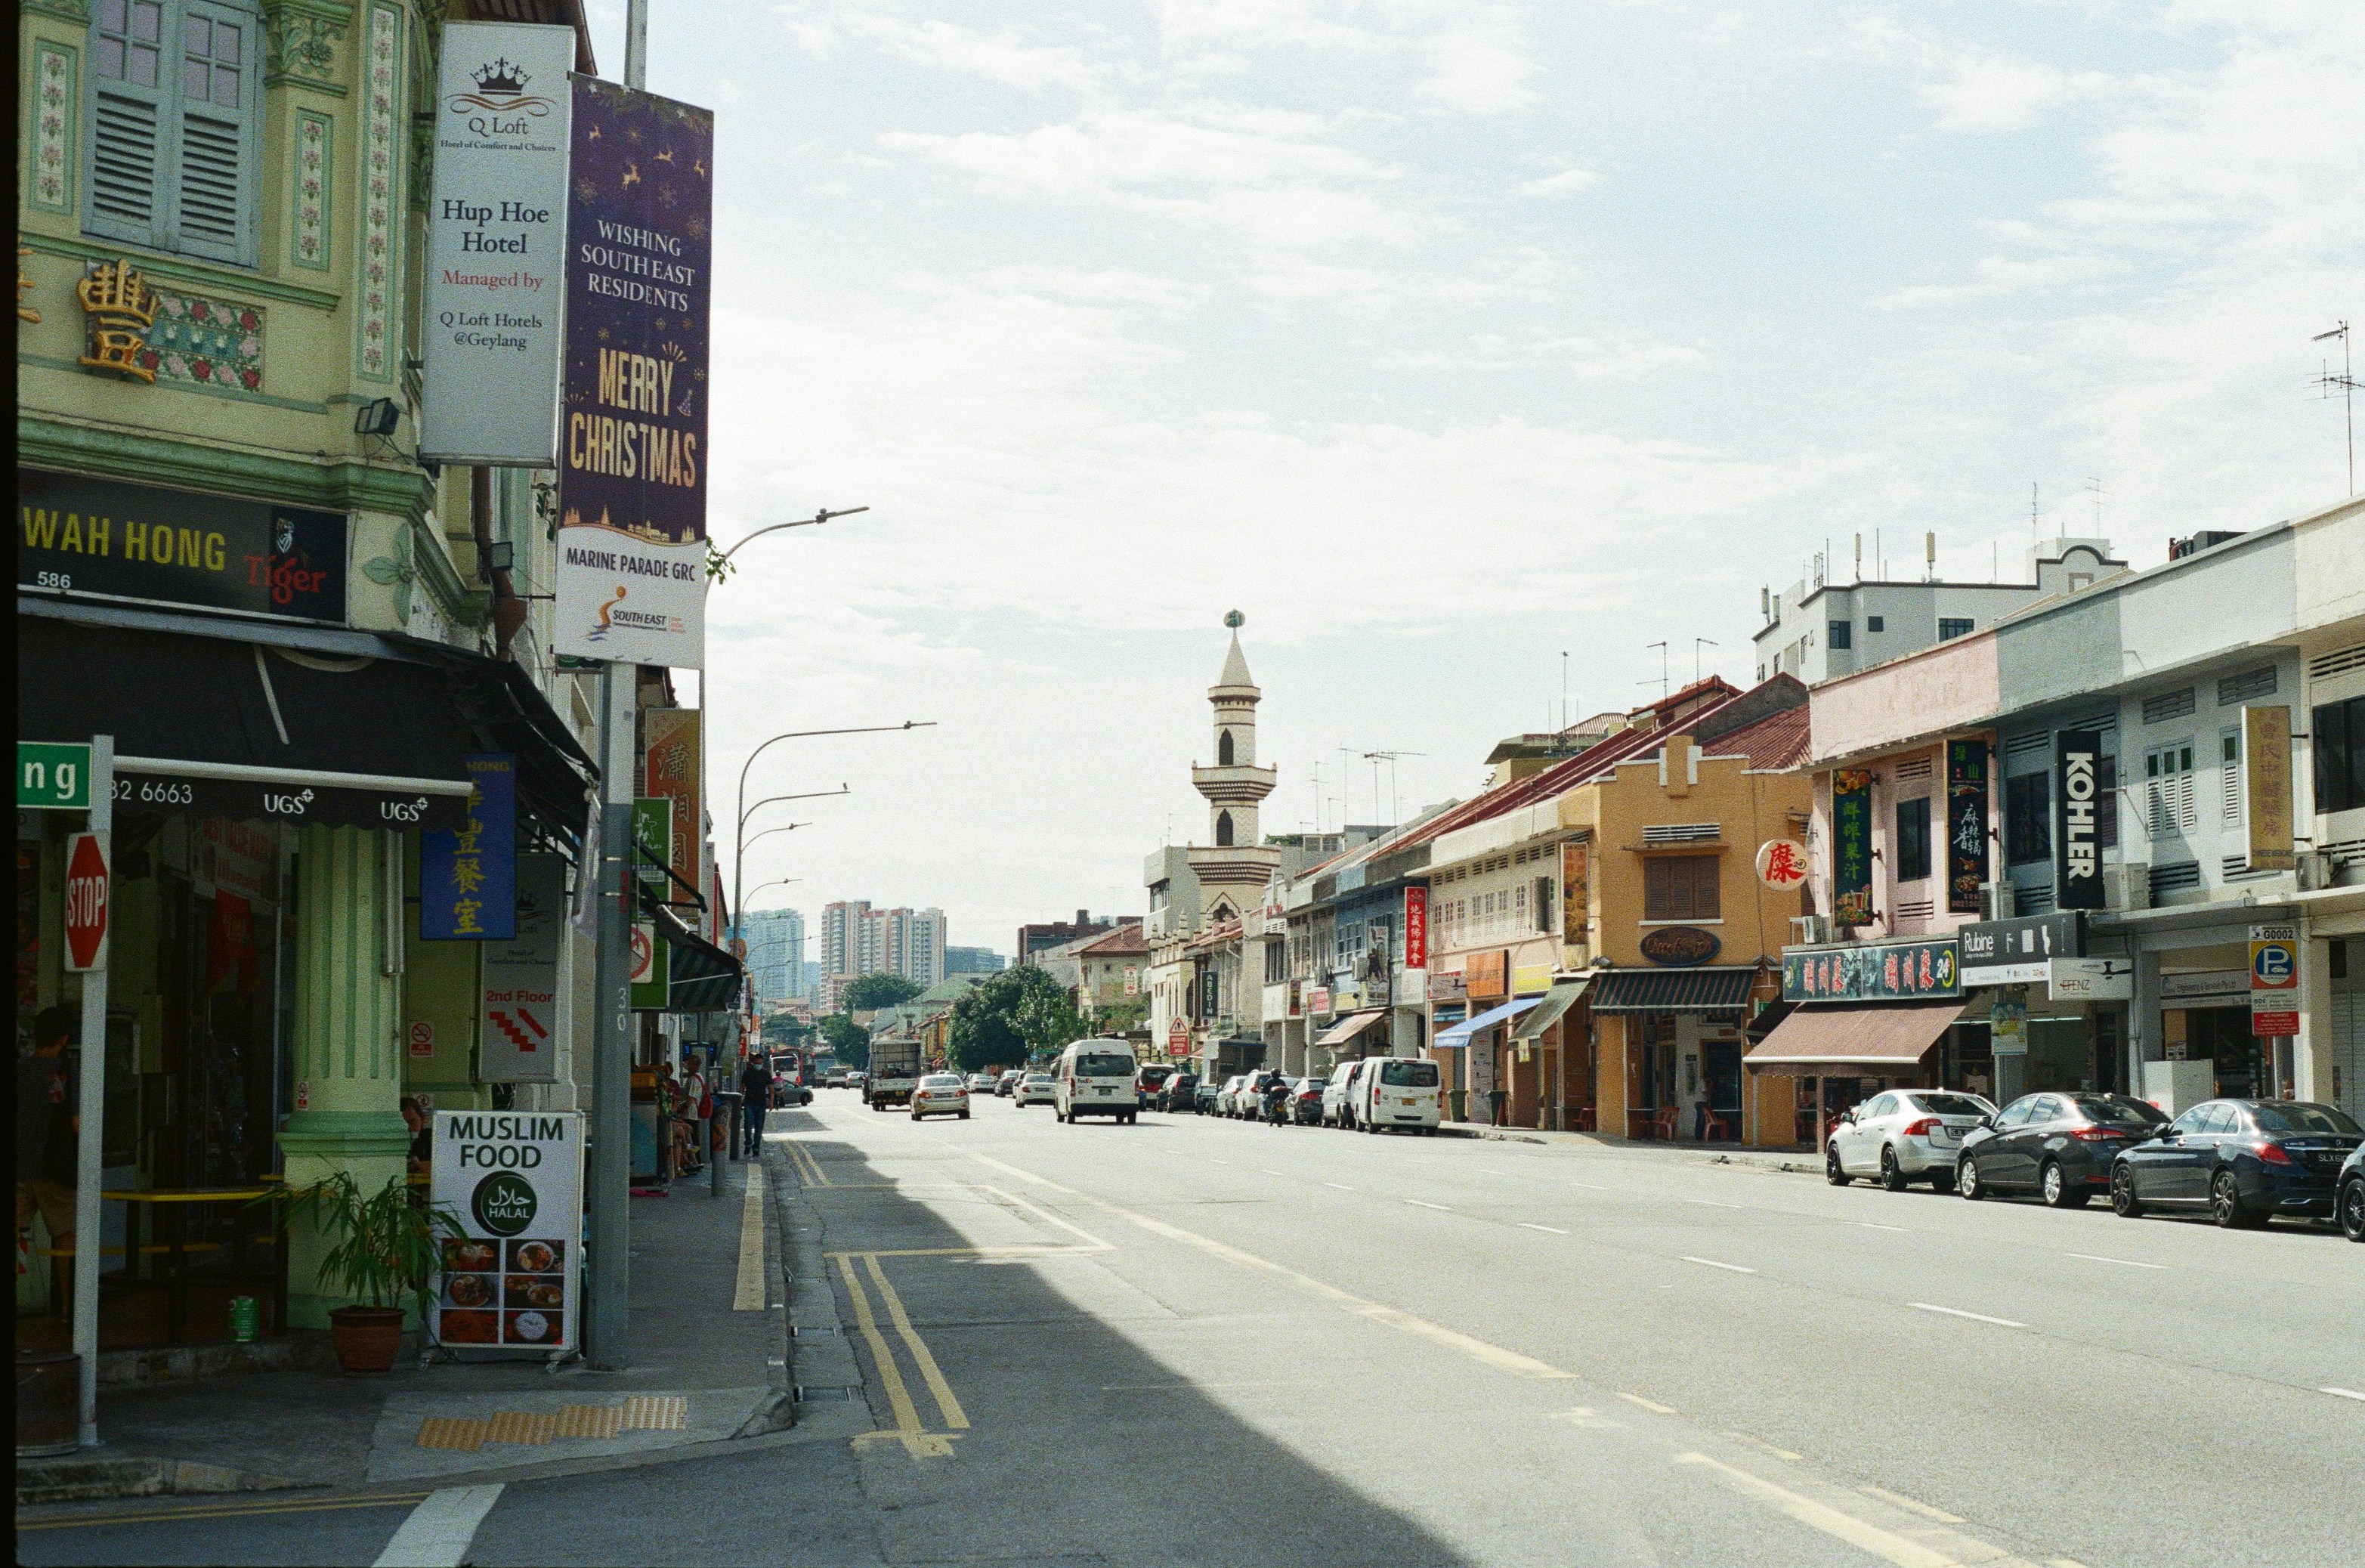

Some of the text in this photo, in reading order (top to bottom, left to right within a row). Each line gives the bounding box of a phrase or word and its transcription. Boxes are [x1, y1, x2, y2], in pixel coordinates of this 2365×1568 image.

[468, 118, 528, 137] Q Loft
[441, 140, 462, 148] Hotel
[474, 141, 507, 150] Comfort
[525, 144, 556, 152] Choices
[442, 200, 549, 226] Hup Hoe
[462, 231, 527, 253] Hotel
[598, 220, 681, 257] WISHING
[443, 269, 544, 292] Managed by
[588, 272, 688, 312] RESIDENTS
[440, 311, 543, 328] Q Loft Hotels
[454, 332, 527, 351] @Geylang
[598, 347, 674, 417] MERRY
[570, 412, 697, 488] CHRISTMAS
[23, 506, 226, 571] WAH HONG
[566, 547, 696, 582] MARINE PARADE GRC
[37, 571, 71, 589] 586
[244, 553, 326, 605] Tiger
[613, 610, 643, 623] SOUTH
[645, 614, 666, 625] EAST
[141, 781, 193, 803] 6663
[264, 793, 305, 814] UGS
[381, 802, 420, 821] UGS
[2065, 752, 2095, 880] KOHLER
[67, 876, 105, 927] STOP
[1965, 932, 1994, 952] Rubine
[2264, 929, 2293, 939] G0002
[487, 990, 553, 1003] 2nd Floor
[450, 1116, 564, 1141] MUSLIM
[460, 1145, 542, 1169] FOOD
[489, 1186, 531, 1207] حلال
[489, 1208, 530, 1219] HALAL
